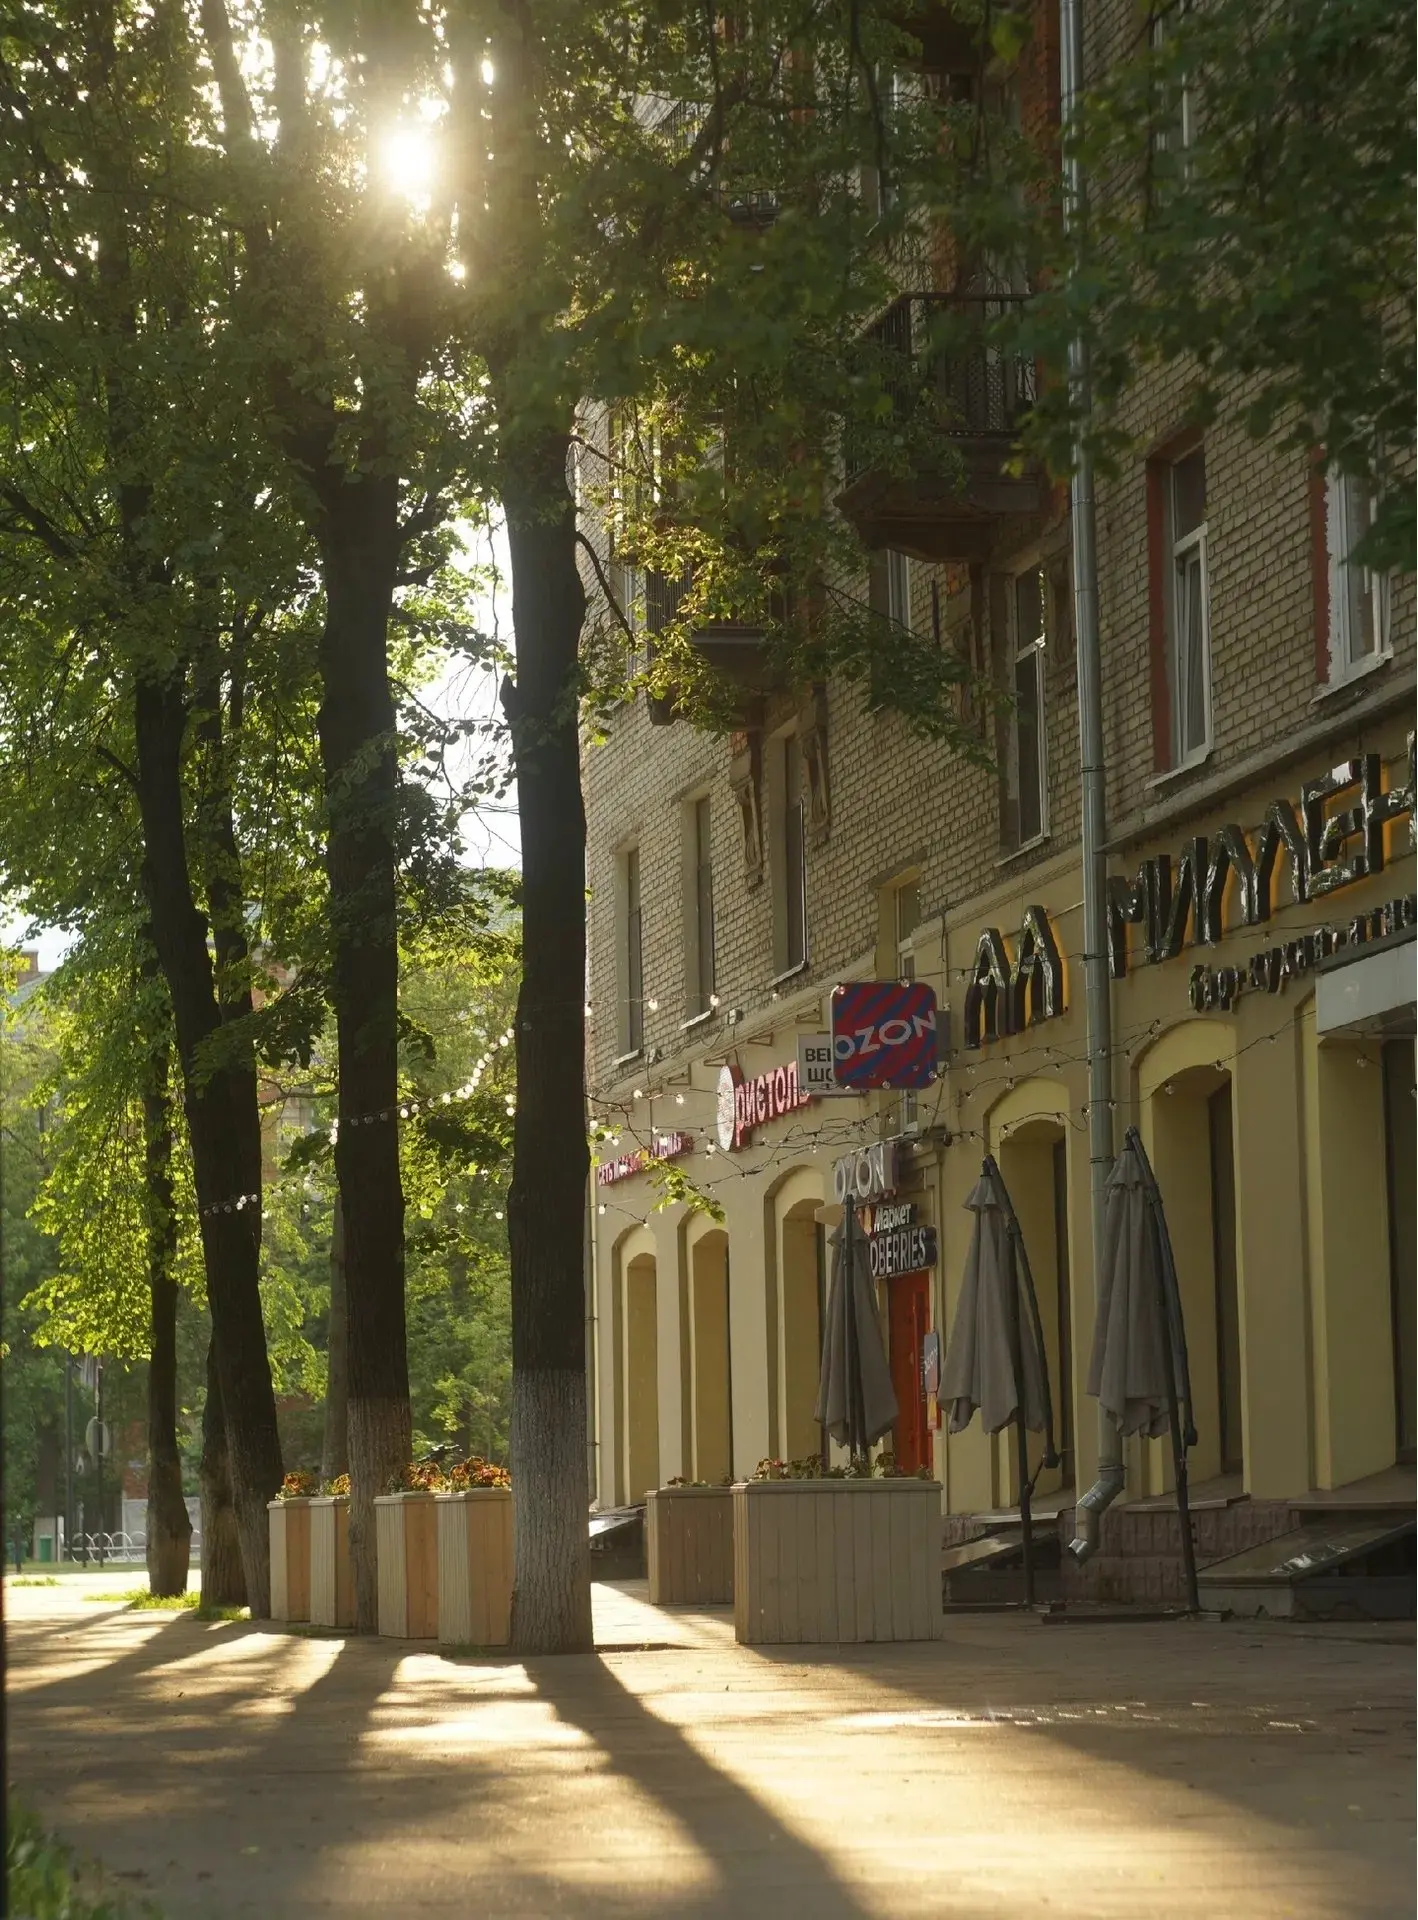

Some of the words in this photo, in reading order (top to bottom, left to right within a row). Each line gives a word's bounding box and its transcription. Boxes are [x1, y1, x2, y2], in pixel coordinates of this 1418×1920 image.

[835, 1010, 937, 1061] OZON
[834, 1145, 889, 1204] OZON
[873, 1204, 912, 1233] Маркет
